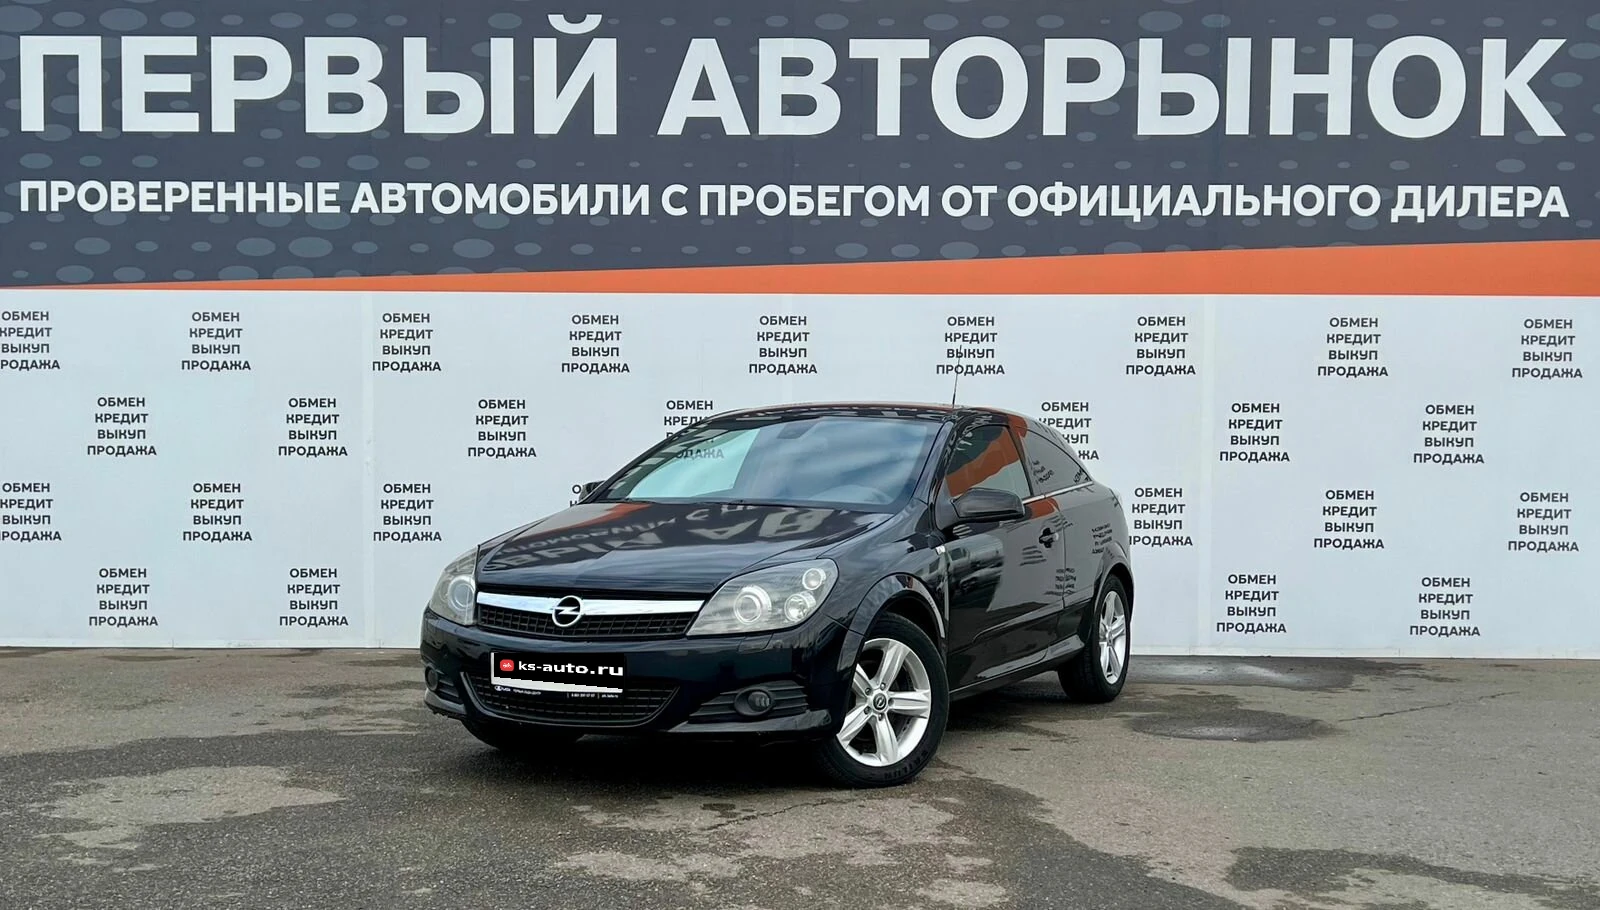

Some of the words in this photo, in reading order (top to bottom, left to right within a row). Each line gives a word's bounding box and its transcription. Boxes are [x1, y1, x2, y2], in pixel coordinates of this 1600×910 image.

[19, 14, 617, 135] ПЕРВЫЙ
[657, 36, 1567, 139] АВТОРЫНОК
[20, 180, 341, 214] ПРОВЕРЕННЫЕ
[350, 182, 650, 216] АВТОМОБИЛИ
[661, 183, 689, 216] С
[699, 184, 930, 217] ПРОБЕГОМ
[941, 185, 998, 217] ОТ
[1007, 181, 1381, 223] ОФИЦИАЛЬНОГО
[1390, 185, 1570, 223] ДИЛЕРА
[1, 310, 49, 321] ОБМЕН
[191, 311, 240, 322] ОБМЕН
[382, 312, 430, 324] ОБМЕН
[571, 314, 619, 325] ОБМЕН
[759, 315, 807, 326] ОБМЕН
[947, 316, 995, 327] ОБМЕН
[1137, 316, 1186, 327] ОБМЕН
[1329, 317, 1379, 328] ОБМЕН
[1523, 318, 1573, 329] ОБМЕН
[0, 327, 53, 339] КРЕДИТ
[189, 327, 243, 340] КРЕДИТ
[379, 328, 434, 341] КРЕДИТ
[569, 330, 623, 343] КРЕДИТ
[756, 331, 811, 344] КРЕДИТ
[944, 332, 998, 345] КРЕДИТ
[1134, 332, 1189, 345] КРЕДИТ
[1326, 333, 1382, 346] КРЕДИТ
[1520, 335, 1576, 348] КРЕДИТ
[1, 343, 50, 354] ВЫКУП
[191, 344, 241, 355] ВЫКУП
[382, 344, 431, 356] ВЫКУП
[571, 346, 620, 357] ВЫКУП
[759, 347, 807, 358] ВЫКУП
[946, 348, 995, 359] ВЫКУП
[1136, 348, 1186, 359] ВЫКУП
[1328, 349, 1378, 361] ВЫКУП
[1522, 351, 1573, 362] ВЫКУП
[0, 359, 61, 372] РОДАЖА
[181, 360, 252, 373] ПРОДАЖА
[372, 361, 442, 374] ПРОДАЖА
[561, 362, 630, 375] ПРОДАЖА
[748, 363, 818, 376] ПРОДАЖА
[936, 364, 1005, 377] ПРОДАЖА
[1125, 364, 1196, 377] ПРОДАЖА
[1317, 365, 1389, 379] ПРОДАЖА
[1511, 367, 1583, 380] ПРОДАЖА
[97, 396, 146, 408] ОБМЕН
[288, 397, 337, 408] ОБМЕН
[478, 399, 526, 410] ОБМЕН
[666, 399, 714, 411] ОБМЕН
[1041, 401, 1089, 412] ОБМЕН
[1231, 402, 1280, 414] ОБМЕН
[1425, 404, 1475, 415] ОБМЕН
[94, 413, 149, 425] КРЕДИТ
[286, 413, 340, 426] КРЕДИТ
[475, 415, 529, 427] КРЕДИТ
[1228, 418, 1284, 432] КРЕДИТ
[1422, 420, 1478, 433] КРЕДИТ
[97, 429, 146, 440] ВЫКУП
[288, 429, 337, 441] ВЫКУП
[478, 431, 527, 442] ВЫКУП
[1061, 433, 1089, 444] КУП
[1230, 435, 1280, 446] ВЫКУП
[1424, 436, 1474, 448] ВЫКУП
[87, 445, 157, 458] ПРОДАЖА
[278, 445, 348, 458] ПРОДАЖА
[467, 446, 537, 459] ПРОДАЖА
[1219, 451, 1291, 464] ПРОДАЖА
[1413, 452, 1485, 466] ПРОДАЖА
[1, 482, 51, 493] ОБМЕН
[192, 482, 241, 493] ОБМЕН
[382, 483, 431, 494] ОБМЕН
[1134, 487, 1183, 498] ОБМЕН
[1325, 489, 1375, 501] ОБМЕН
[1519, 491, 1569, 503] ОБМЕН
[0, 498, 54, 511] КРЕДИТ
[190, 498, 245, 511] КРЕДИТ
[380, 499, 435, 512] КРЕДИТ
[1131, 503, 1186, 516] КРЕДИТ
[1322, 505, 1378, 519] КРЕДИТ
[1517, 508, 1572, 521] КРЕДИТ
[2, 514, 51, 525] ВЫКУП
[193, 514, 242, 526] ВЫКУП
[383, 515, 432, 526] ВЫКУП
[1133, 519, 1183, 530] ВЫКУП
[1324, 521, 1374, 533] ВЫКУП
[1519, 524, 1569, 536] ВЫКУП
[1, 530, 62, 543] РОДАЖА
[182, 531, 253, 543] ПРОДАЖА
[373, 531, 442, 544] ПРОДАЖА
[1313, 537, 1385, 551] ПРОДАЖА
[1507, 540, 1580, 553] ПРОДАЖА
[98, 567, 147, 578] ОБМЕН
[289, 567, 338, 579] ОБМЕН
[1227, 573, 1277, 585] ОБМЕН
[1421, 576, 1471, 588] ОБМЕН
[96, 583, 151, 596] КРЕДИТ
[287, 583, 341, 596] КРЕДИТ
[1225, 590, 1280, 603] КРЕДИТ
[1418, 593, 1474, 606] КРЕДИТ
[99, 599, 148, 611] ВЫКУП
[289, 599, 338, 611] ВЫКУП
[1227, 606, 1276, 617] ВЫКУП
[1420, 609, 1470, 620] ВЫКУП
[88, 616, 159, 628] ПРОДАЖА
[279, 615, 349, 628] ПРОДАЖА
[1216, 622, 1287, 635] ПРОДАЖА
[1409, 625, 1481, 638] ПРОДАЖА
